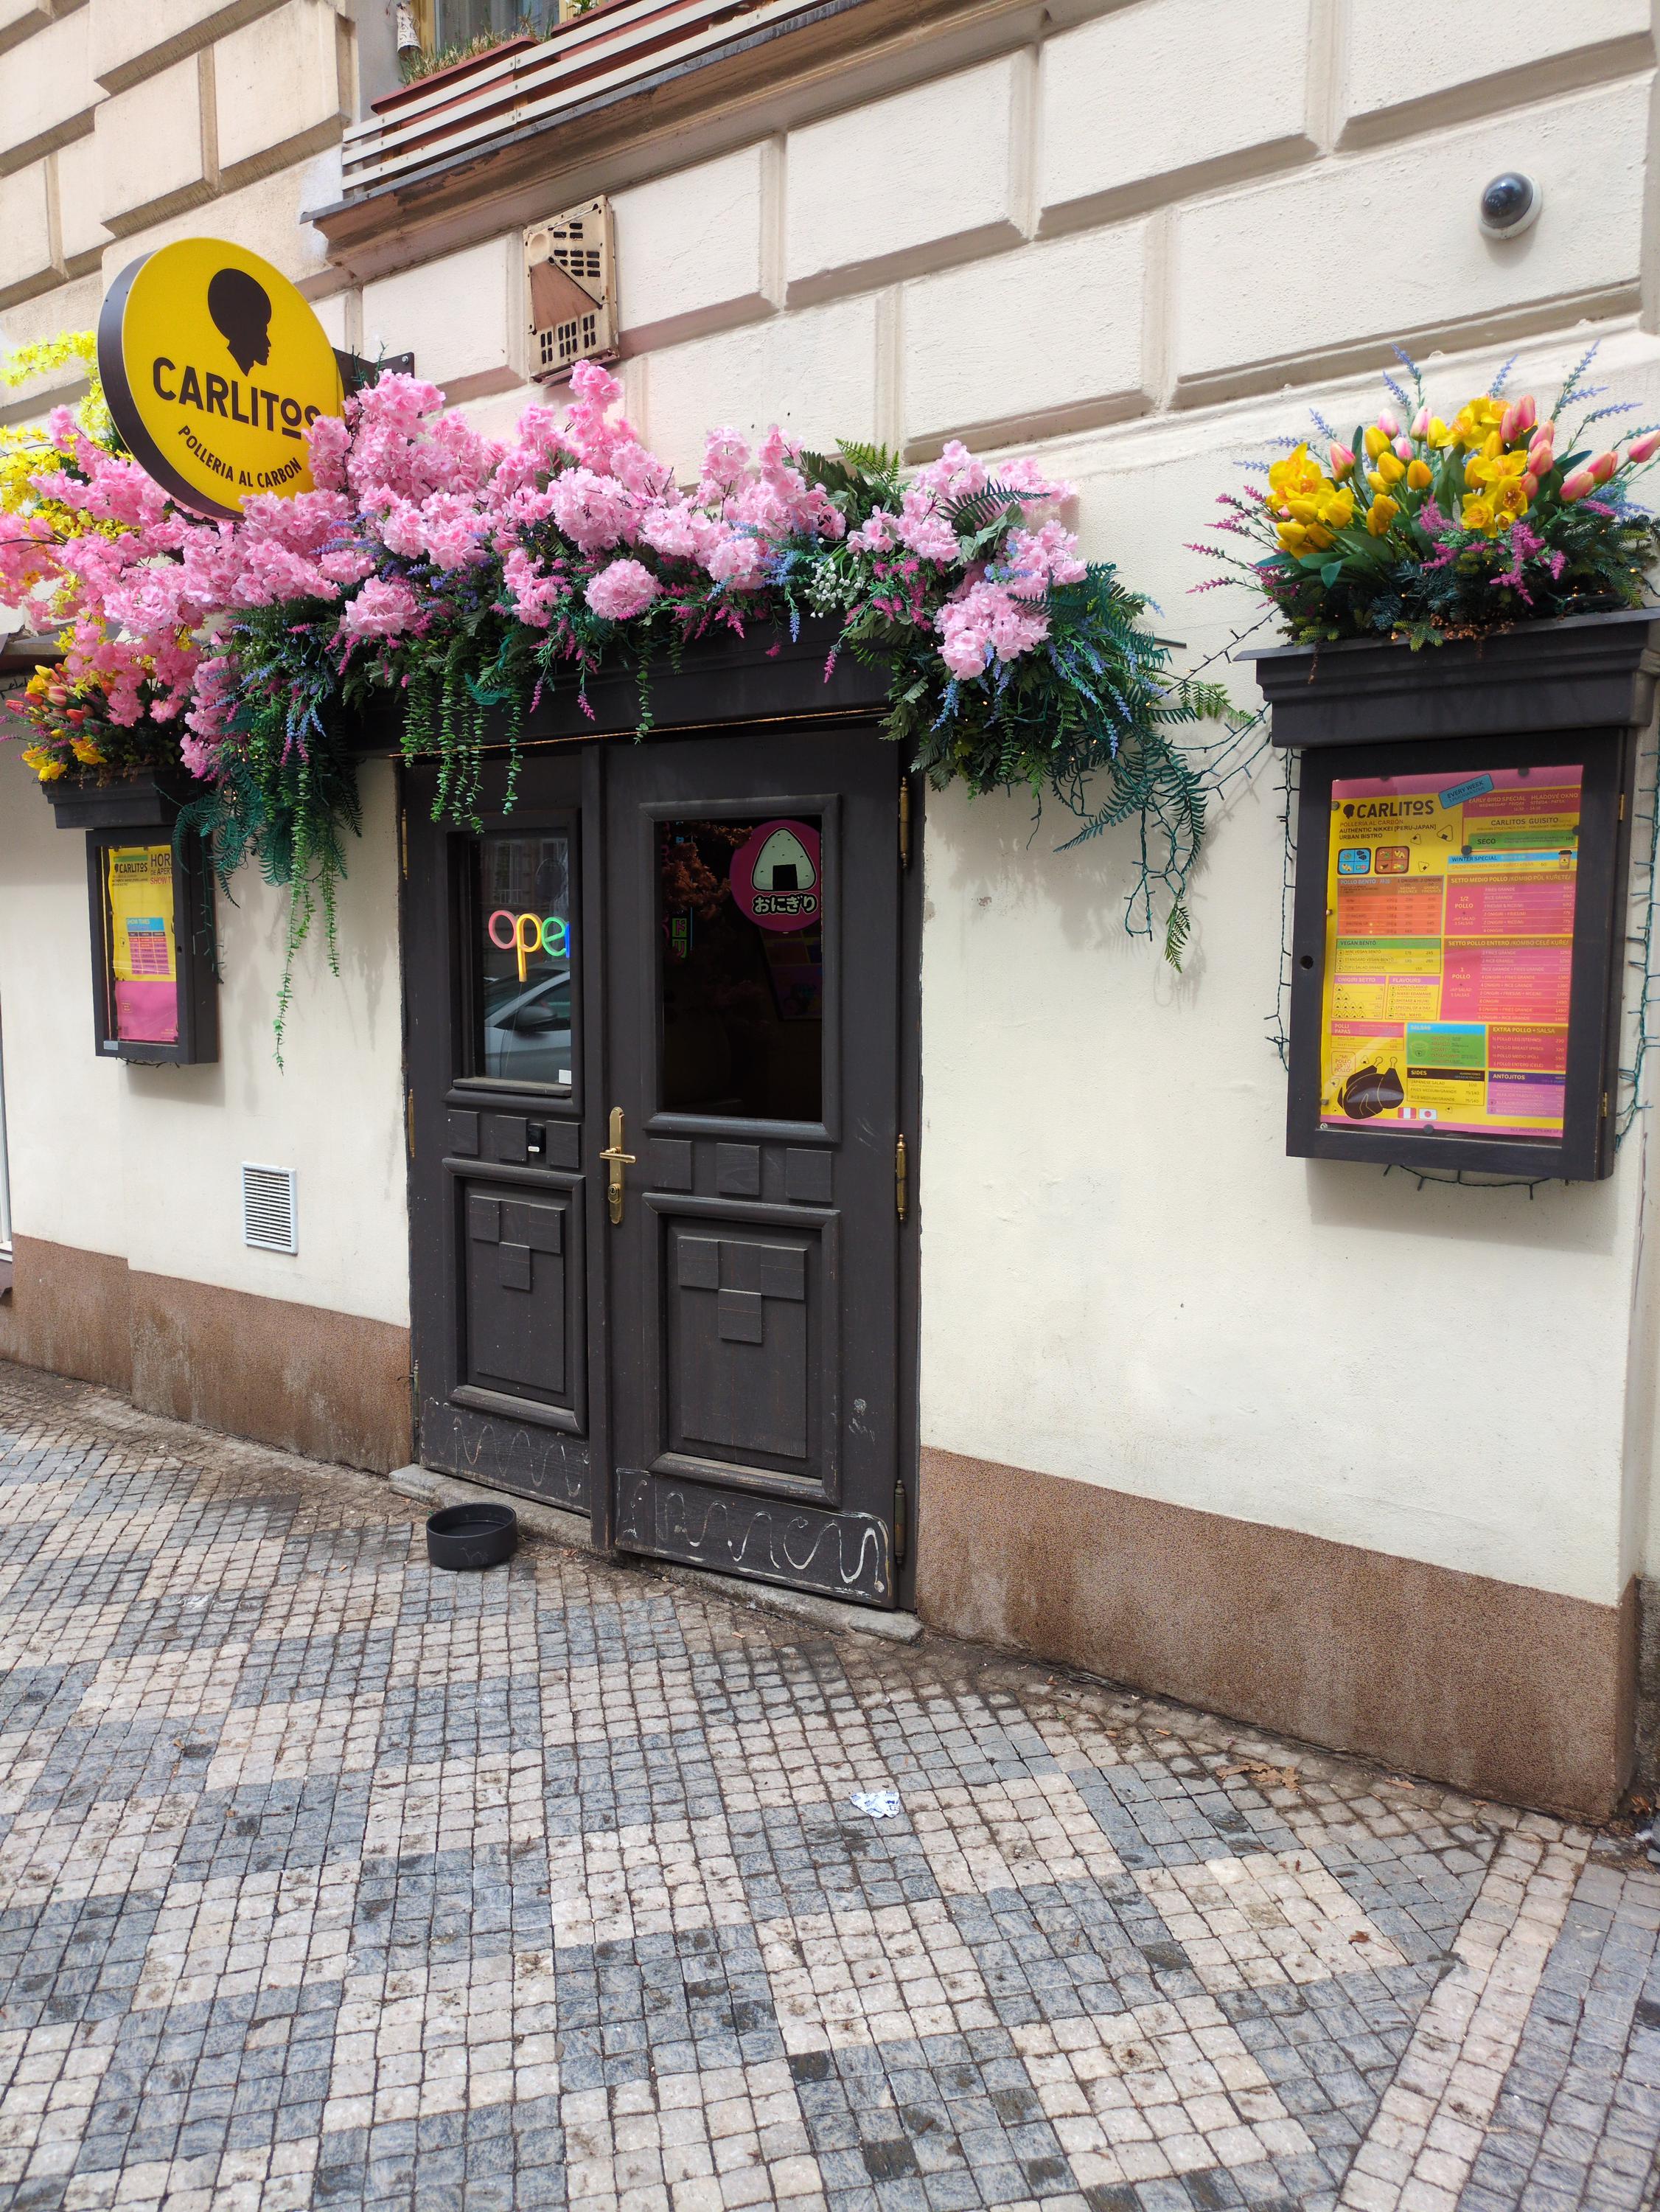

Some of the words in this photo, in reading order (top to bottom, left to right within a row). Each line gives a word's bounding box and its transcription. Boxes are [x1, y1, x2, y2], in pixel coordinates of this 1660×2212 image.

[178, 425, 234, 482] POLLERIA
[239, 471, 254, 487] AL
[257, 457, 302, 488] CARBON
[1447, 787, 1465, 799] EVERY
[1466, 780, 1484, 790] WEEK
[1357, 800, 1434, 818] CARLITOS
[1394, 824, 1436, 832] [PERU-JAPAN]
[119, 863, 147, 873] CARLITOS
[150, 876, 167, 885] SHOW
[753, 894, 817, 915] おにぎり
